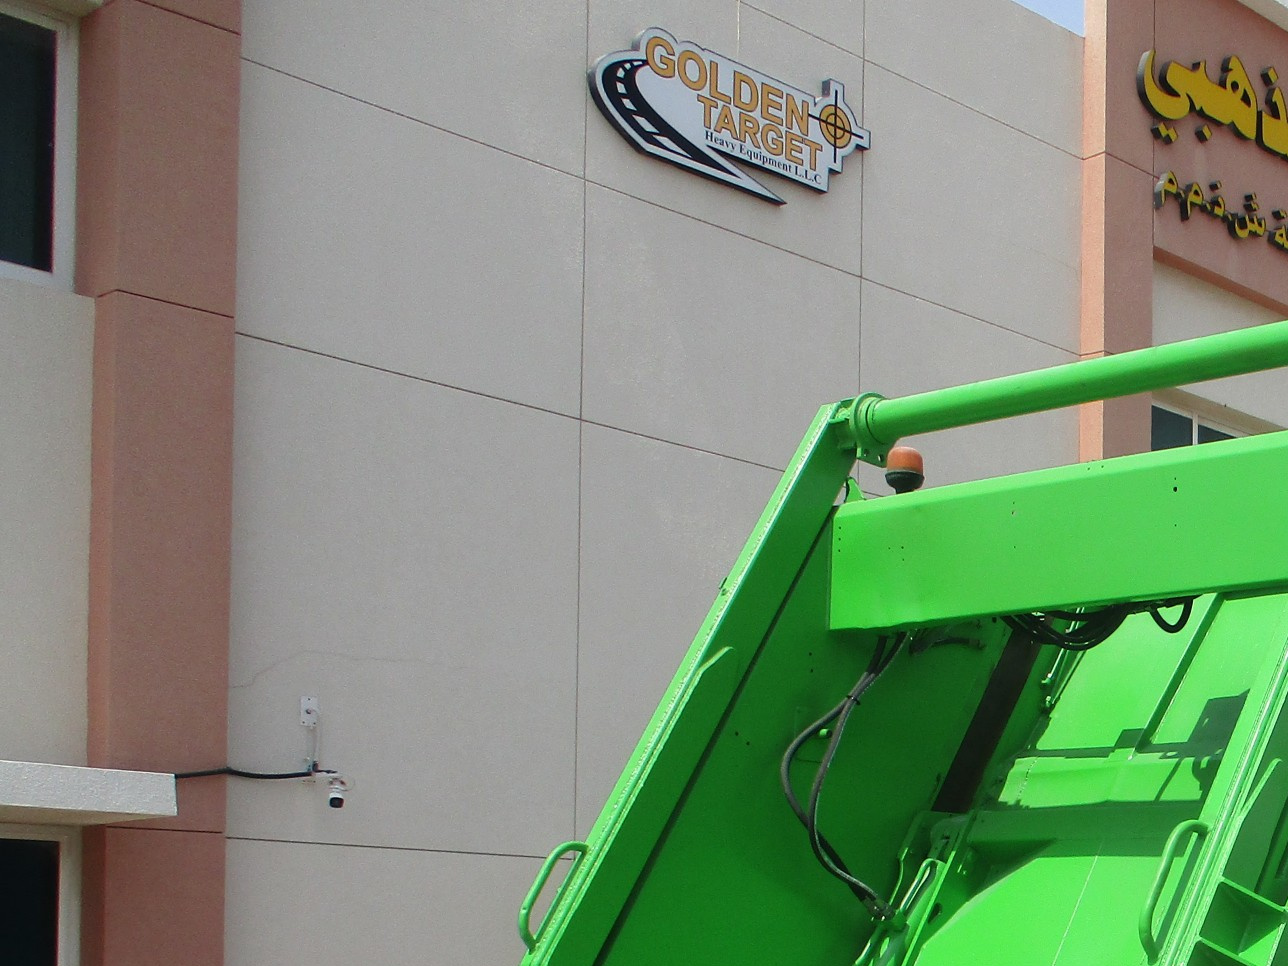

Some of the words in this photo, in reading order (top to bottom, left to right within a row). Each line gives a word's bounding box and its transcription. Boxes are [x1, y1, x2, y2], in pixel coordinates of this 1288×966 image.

[646, 36, 809, 136] GOLDEN
[697, 95, 822, 171] TARGET
[705, 130, 736, 153] Heavy
[739, 143, 792, 173] Equipment
[795, 165, 822, 185] L.L.C
